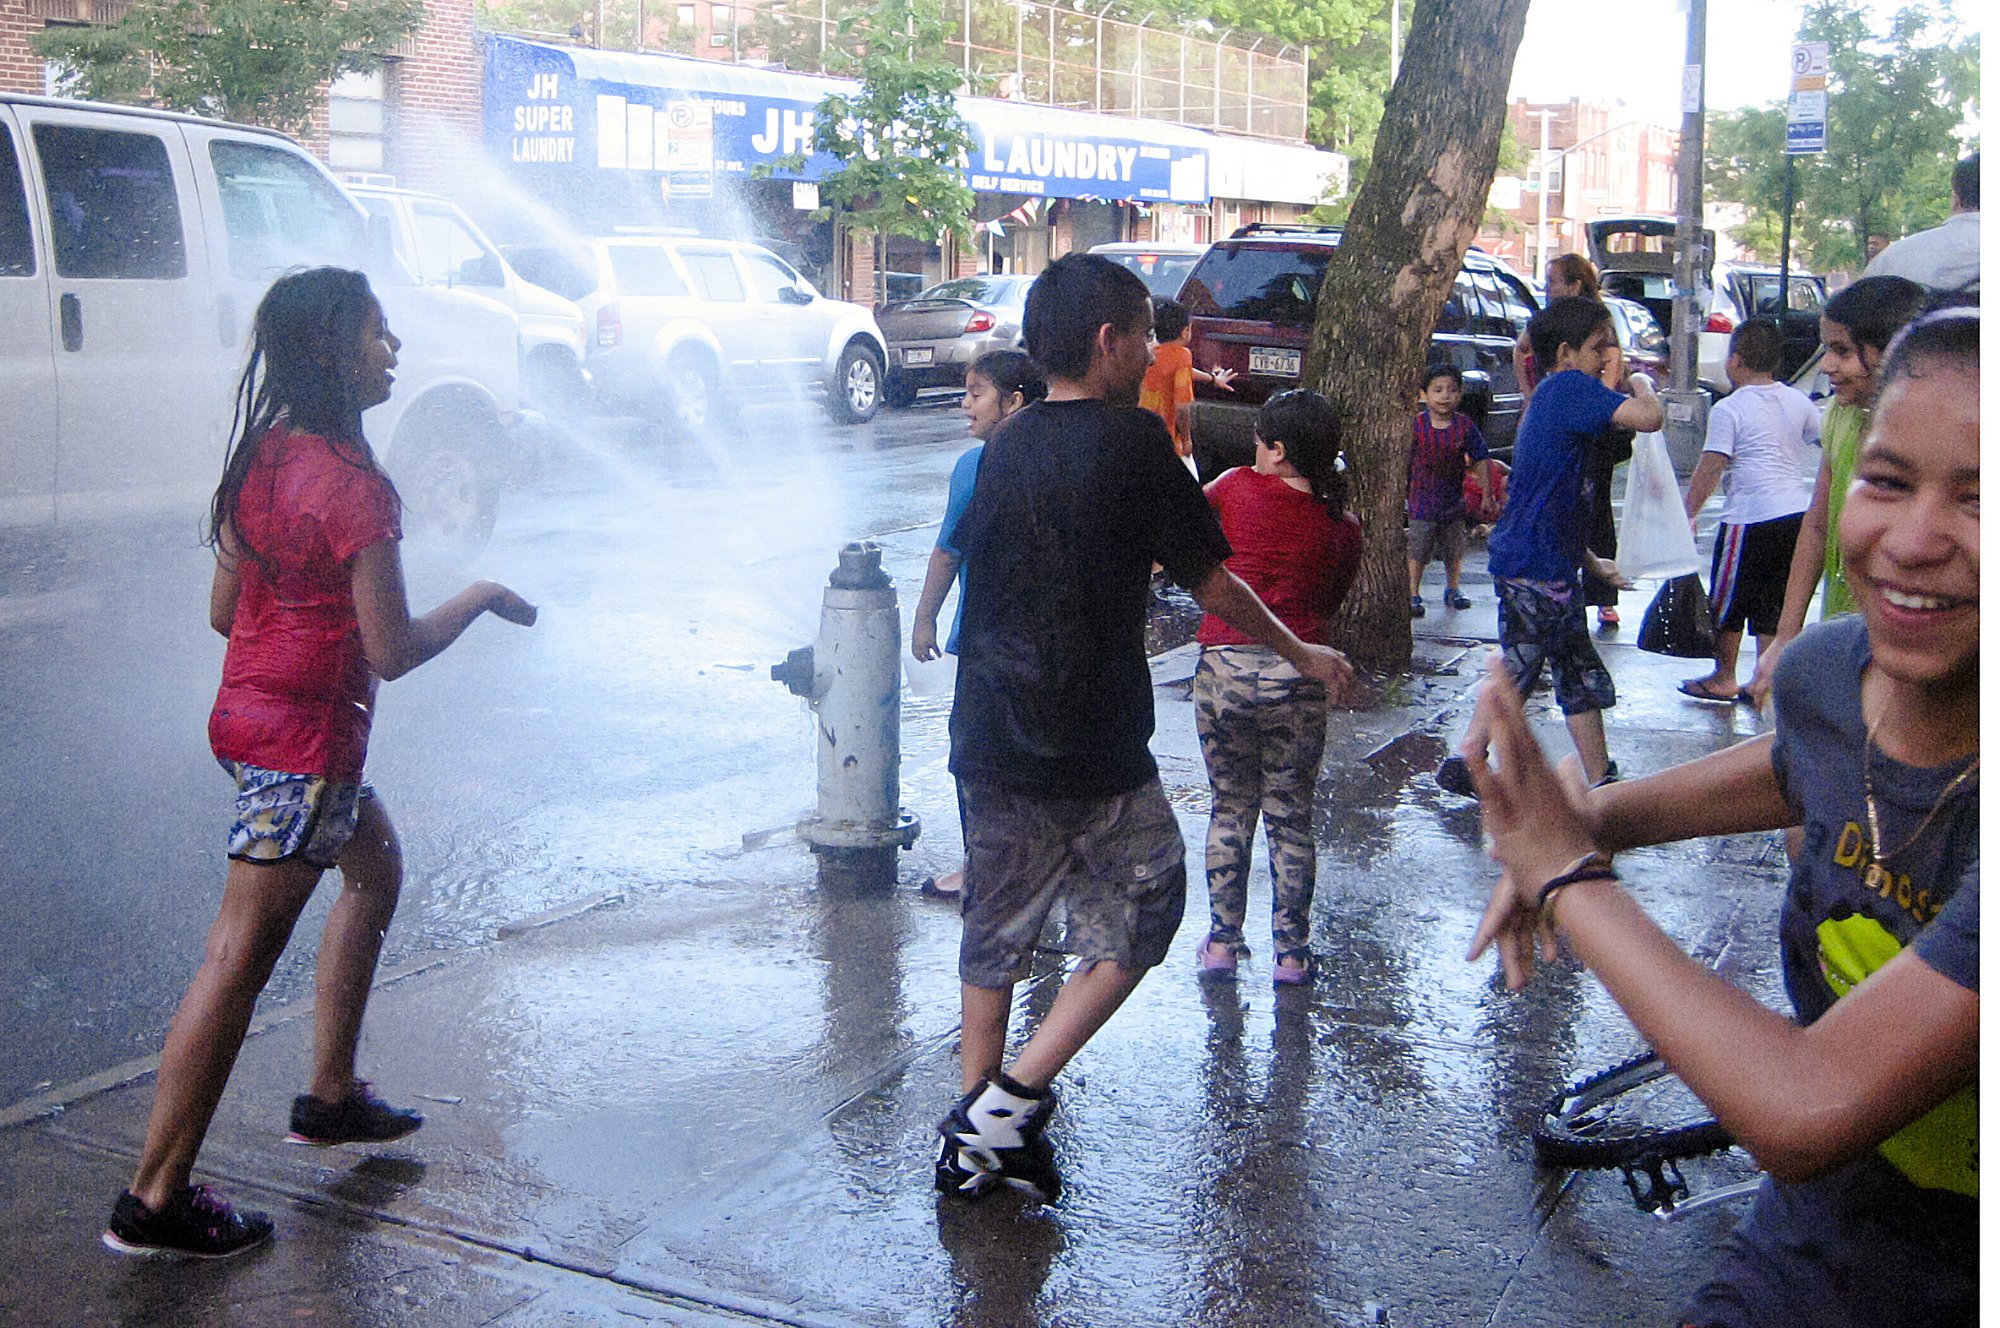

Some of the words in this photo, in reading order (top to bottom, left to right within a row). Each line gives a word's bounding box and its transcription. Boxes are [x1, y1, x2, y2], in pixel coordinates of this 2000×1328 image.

[527, 74, 558, 99] JH
[514, 106, 574, 132] SUPER
[512, 136, 575, 163] LAUNDRY
[751, 108, 815, 156] JH
[984, 132, 1138, 182] LAUNDRY
[971, 174, 999, 190] SELF
[999, 177, 1045, 194] SERVICE
